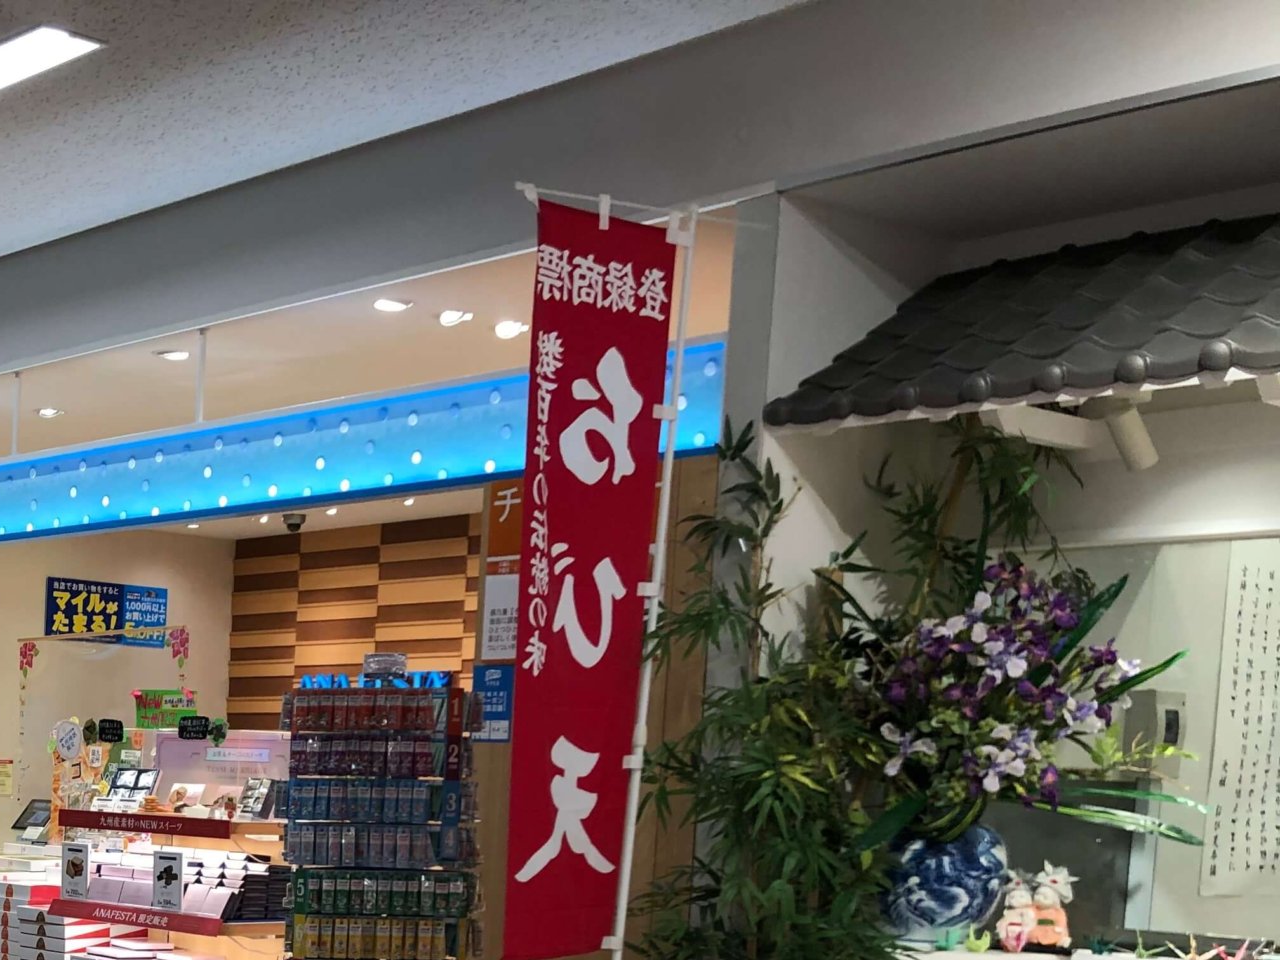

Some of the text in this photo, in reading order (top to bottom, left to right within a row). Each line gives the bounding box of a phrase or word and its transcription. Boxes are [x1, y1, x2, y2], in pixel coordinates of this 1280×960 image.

[53, 581, 120, 596] 当店でお買い物をすると
[52, 590, 119, 614] マイルが
[125, 601, 167, 614] 1,000円以上
[125, 611, 166, 624] お買い上げで
[99, 815, 184, 832] 九州産素材のNEWスイーツ
[92, 907, 169, 928] ANAFESTA 限定販売
